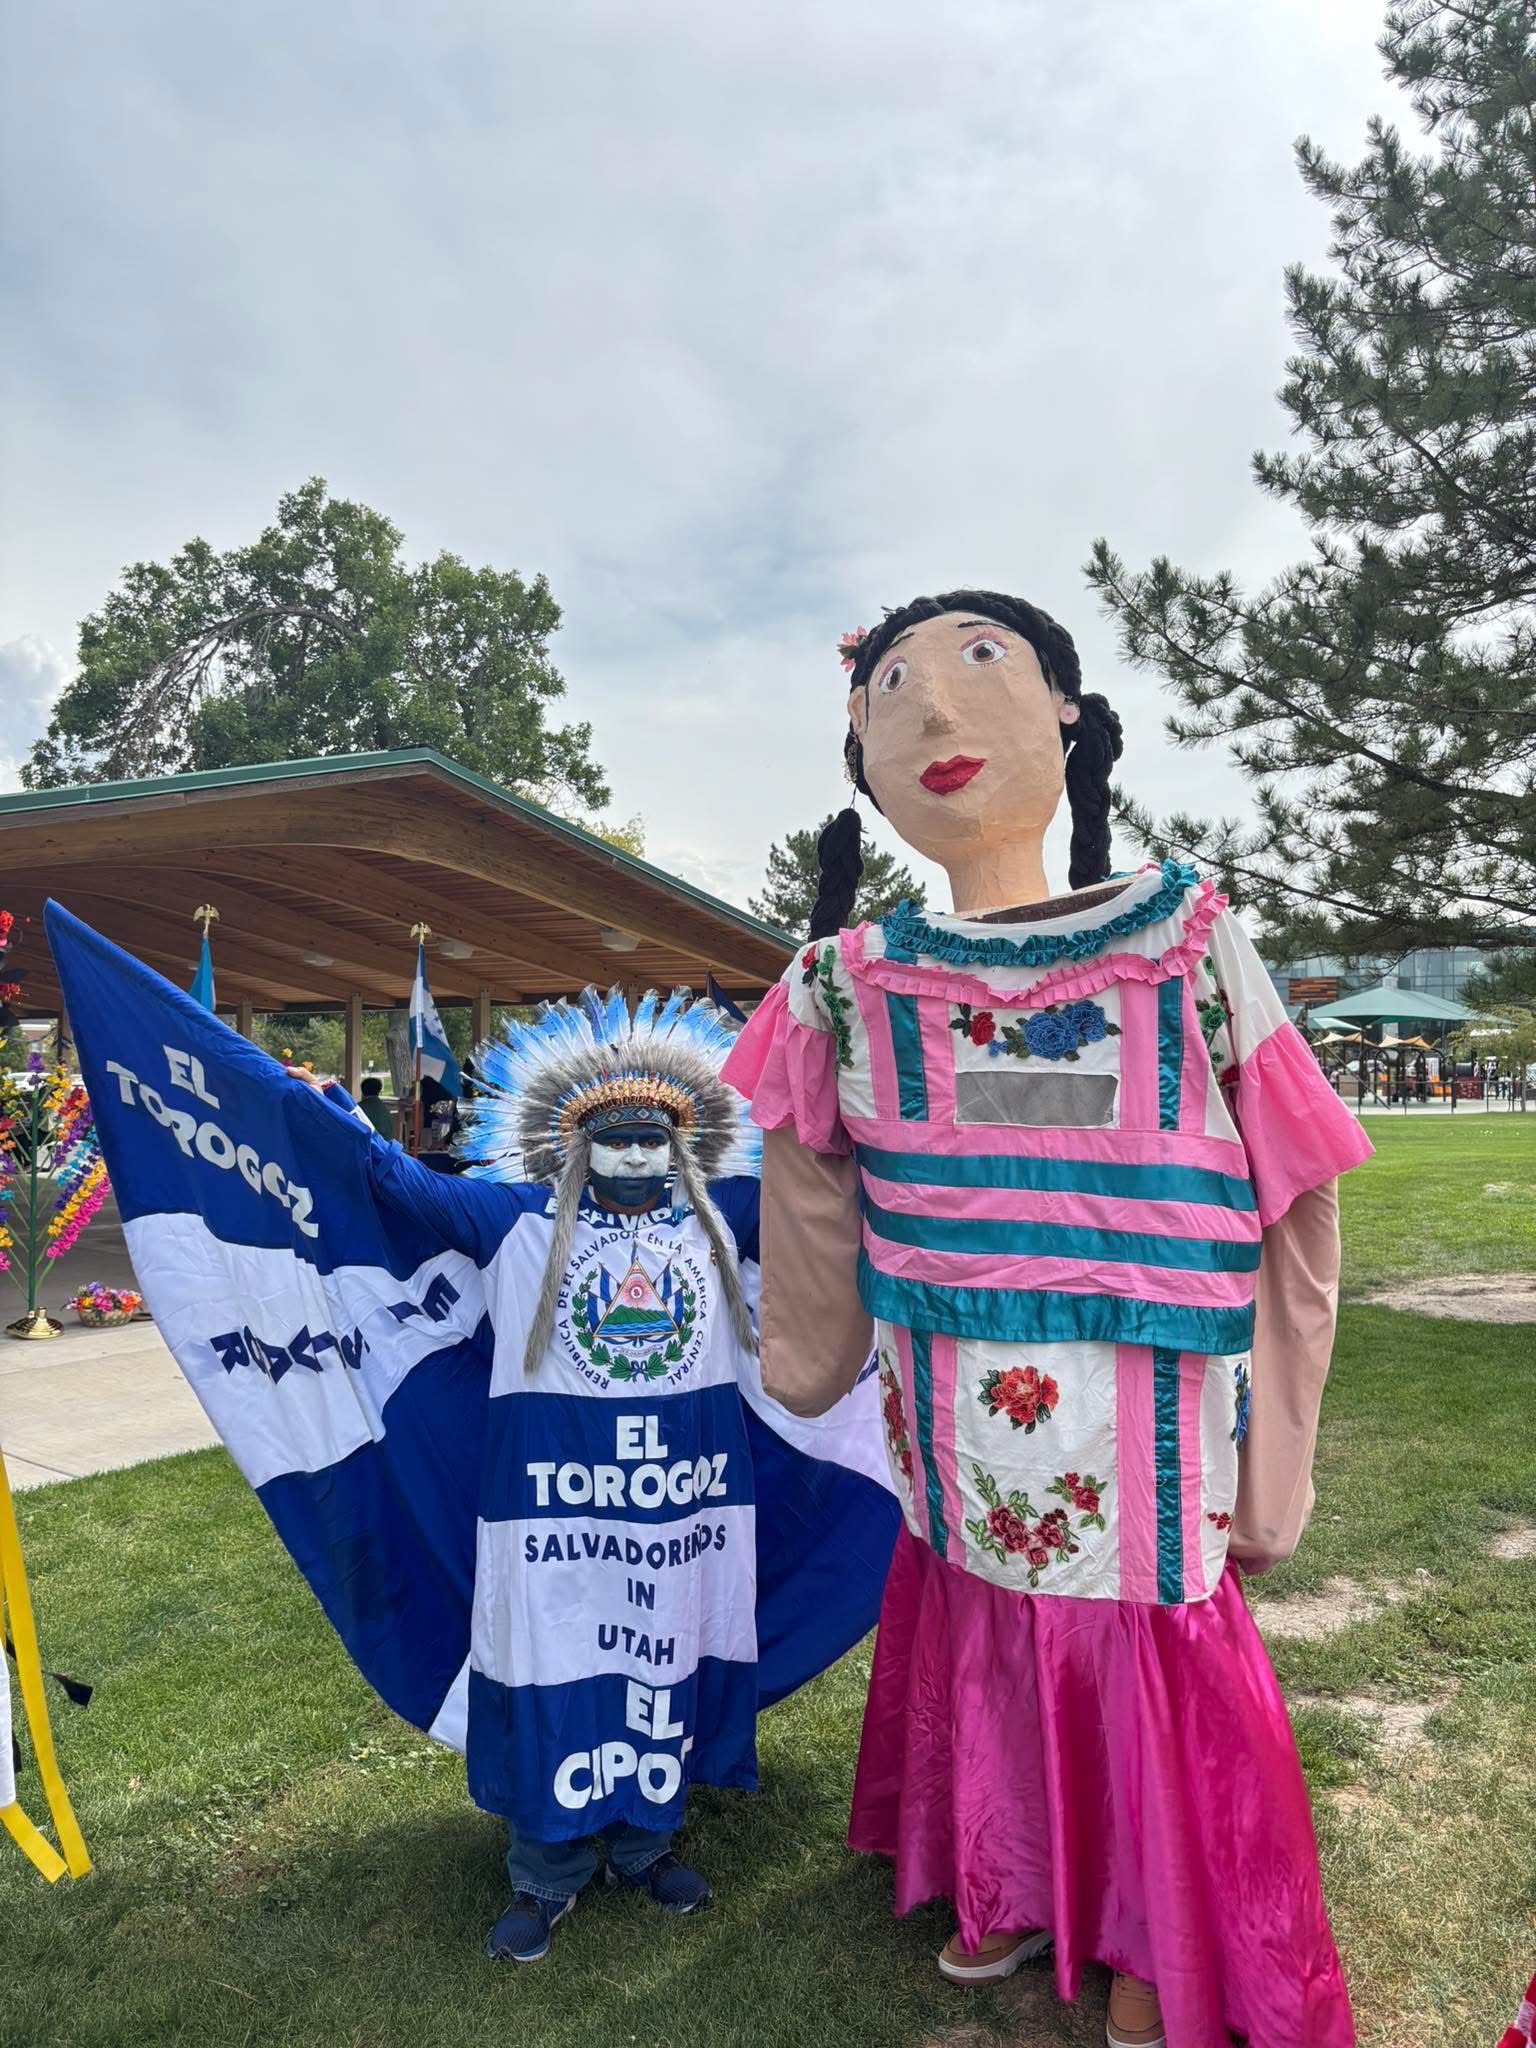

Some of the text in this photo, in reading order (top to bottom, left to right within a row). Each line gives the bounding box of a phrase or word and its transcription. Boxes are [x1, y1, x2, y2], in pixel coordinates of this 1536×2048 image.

[162, 1044, 220, 1110] EL
[570, 1231, 640, 1271] SALVADOR
[647, 1233, 663, 1247] EN
[668, 1240, 682, 1255] LA
[558, 1290, 569, 1309] DE
[563, 1272, 575, 1287] EL
[684, 1257, 707, 1320] AMÉRICA
[558, 1319, 610, 1390] REPÚBLICA
[667, 1330, 704, 1386] CENTRAL
[616, 1415, 668, 1460] EL
[526, 1453, 728, 1509] TOROGOZ
[525, 1523, 726, 1570] SALVADOREÑOS
[627, 1577, 655, 1610] IN
[598, 1624, 675, 1665] UTAH
[626, 1679, 684, 1740] EL
